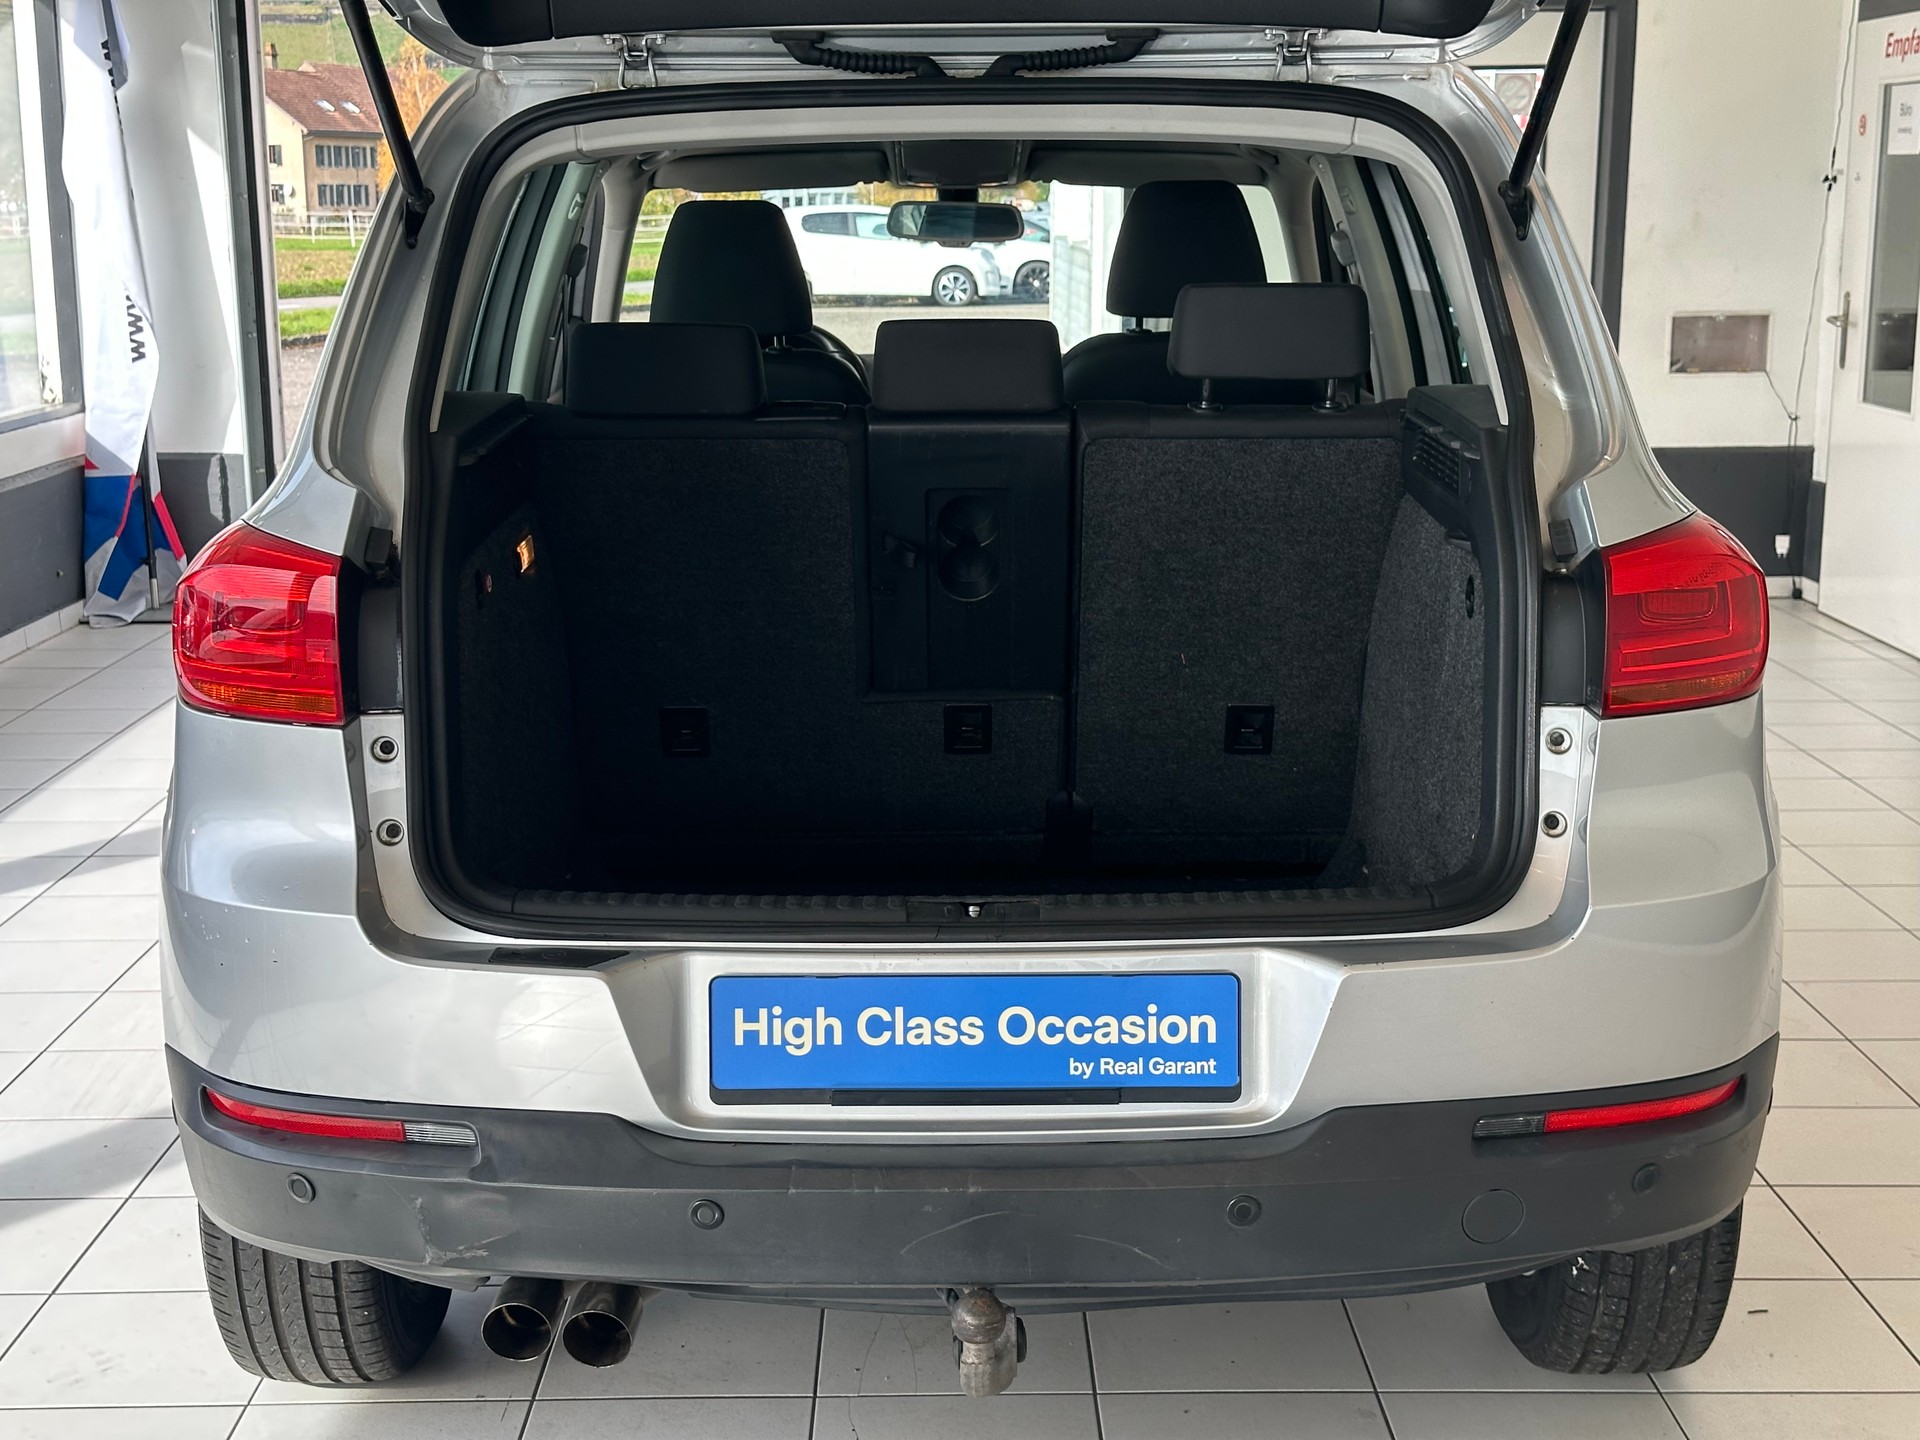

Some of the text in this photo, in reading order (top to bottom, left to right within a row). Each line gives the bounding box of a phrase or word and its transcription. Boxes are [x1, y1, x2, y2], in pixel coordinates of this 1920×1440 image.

[735, 1004, 1217, 1056] High Class Occasion
[1069, 1057, 1217, 1079] by Real Garant
